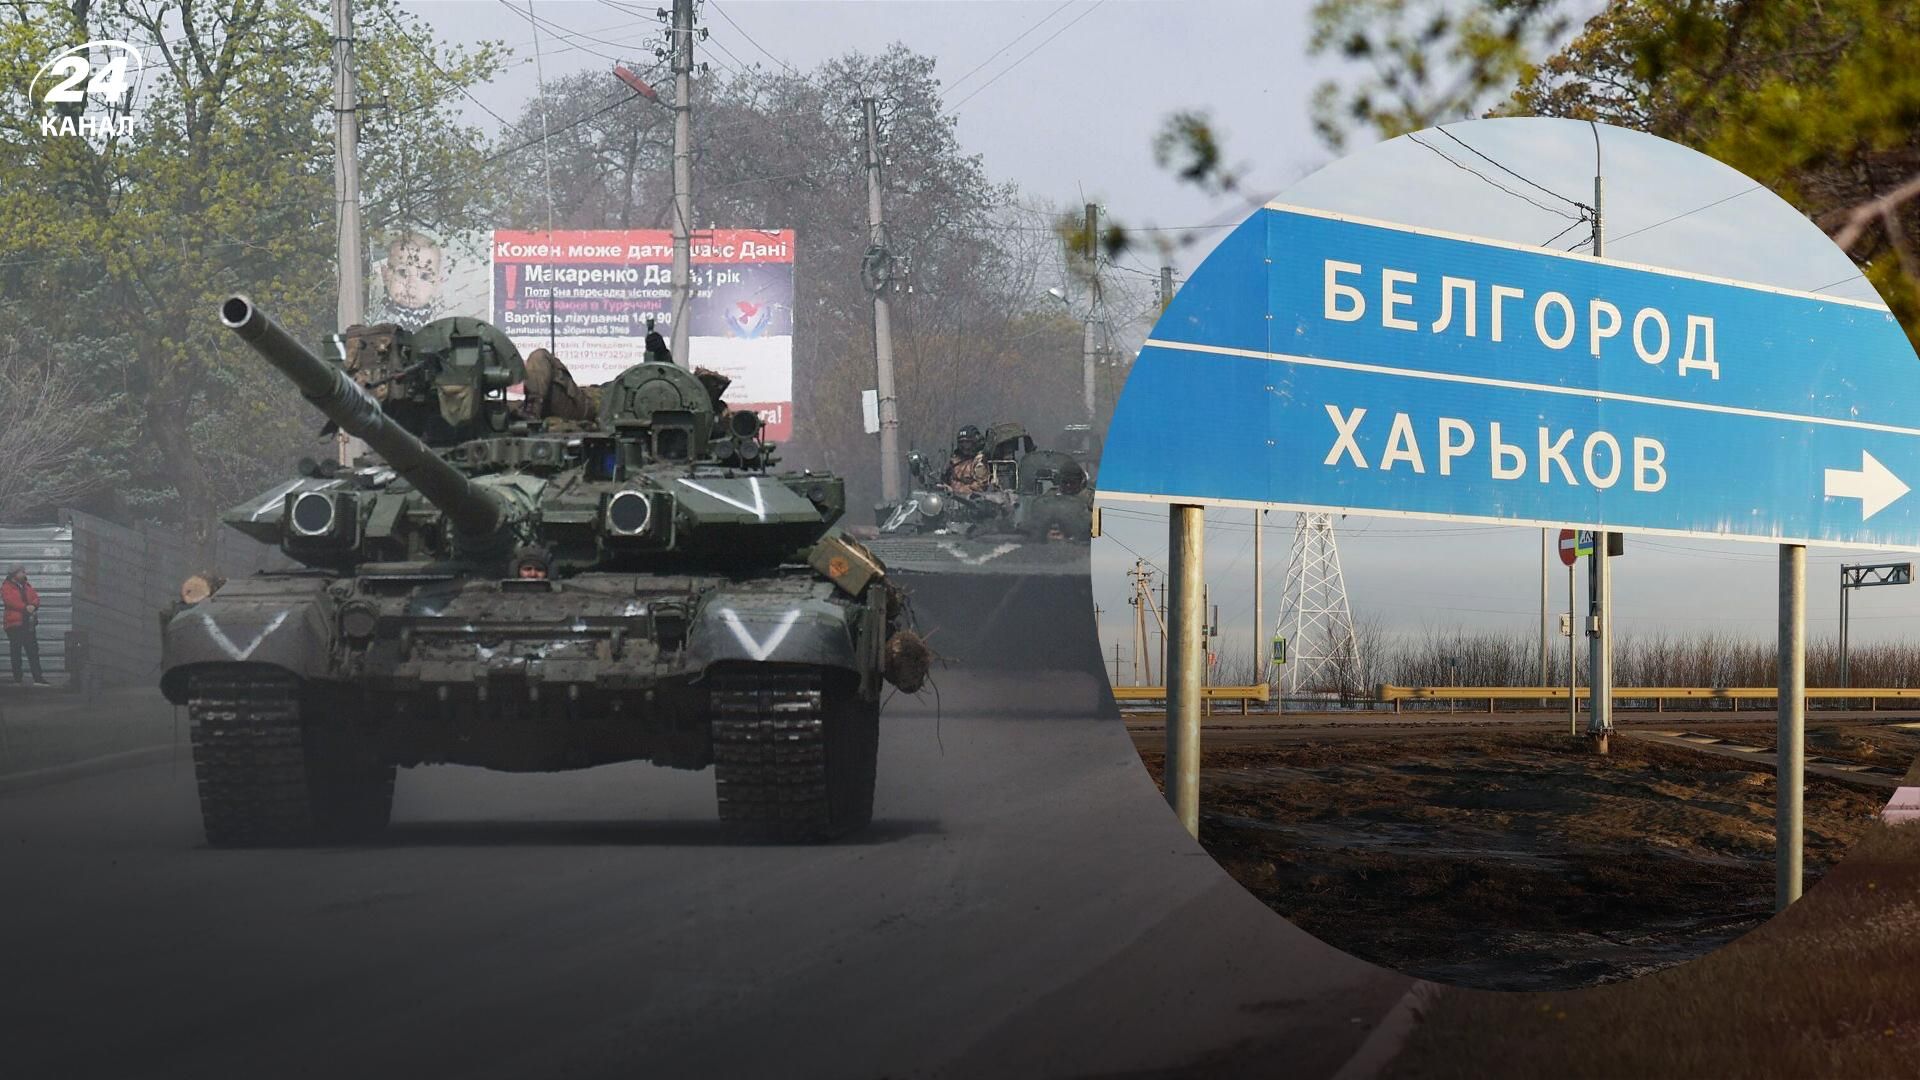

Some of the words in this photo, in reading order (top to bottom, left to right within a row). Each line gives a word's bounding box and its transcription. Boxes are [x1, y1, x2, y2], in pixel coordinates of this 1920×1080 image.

[498, 242, 561, 257] Кожен
[568, 245, 622, 257] може
[628, 245, 673, 259] дати
[739, 241, 786, 259] Дані
[525, 265, 638, 285] Макаренко
[644, 265, 702, 285] Даі,
[706, 269, 713, 283] 1
[717, 269, 741, 286] рік
[525, 286, 572, 298] Потрбна
[505, 311, 562, 325] Вартість
[565, 312, 629, 326] лікування
[1323, 258, 1721, 381] БЕЛГОРОД
[758, 405, 782, 424] га!
[1323, 404, 1669, 494] ХАРЬКОВ
[719, 608, 801, 661] V
